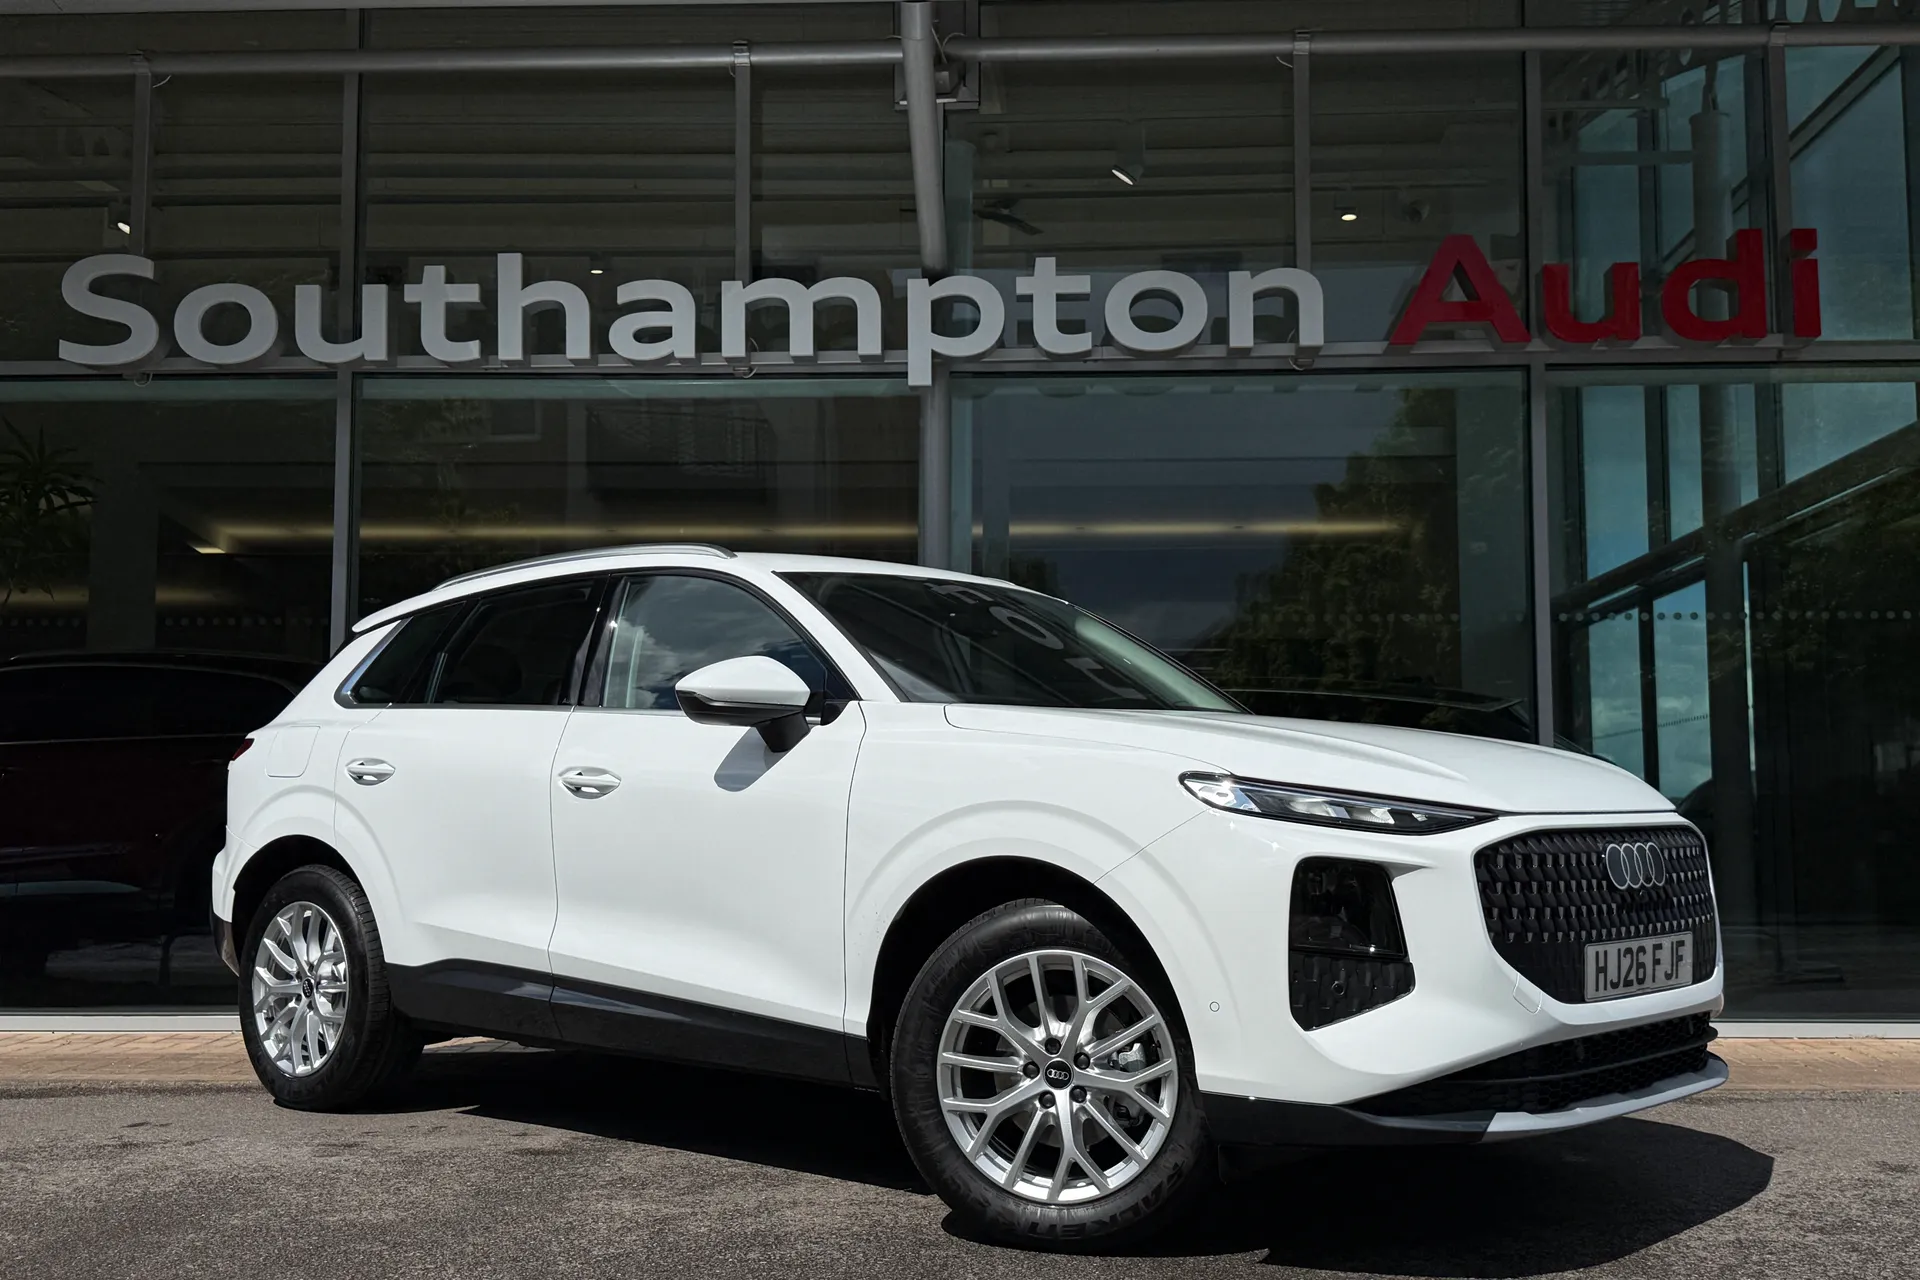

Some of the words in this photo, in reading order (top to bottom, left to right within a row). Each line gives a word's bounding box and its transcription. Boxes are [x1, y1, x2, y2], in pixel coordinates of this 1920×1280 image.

[58, 252, 1325, 387] Southampton
[1389, 228, 1822, 347] Audi
[1595, 945, 1647, 992] HJ26
[1652, 939, 1686, 983] FJF
